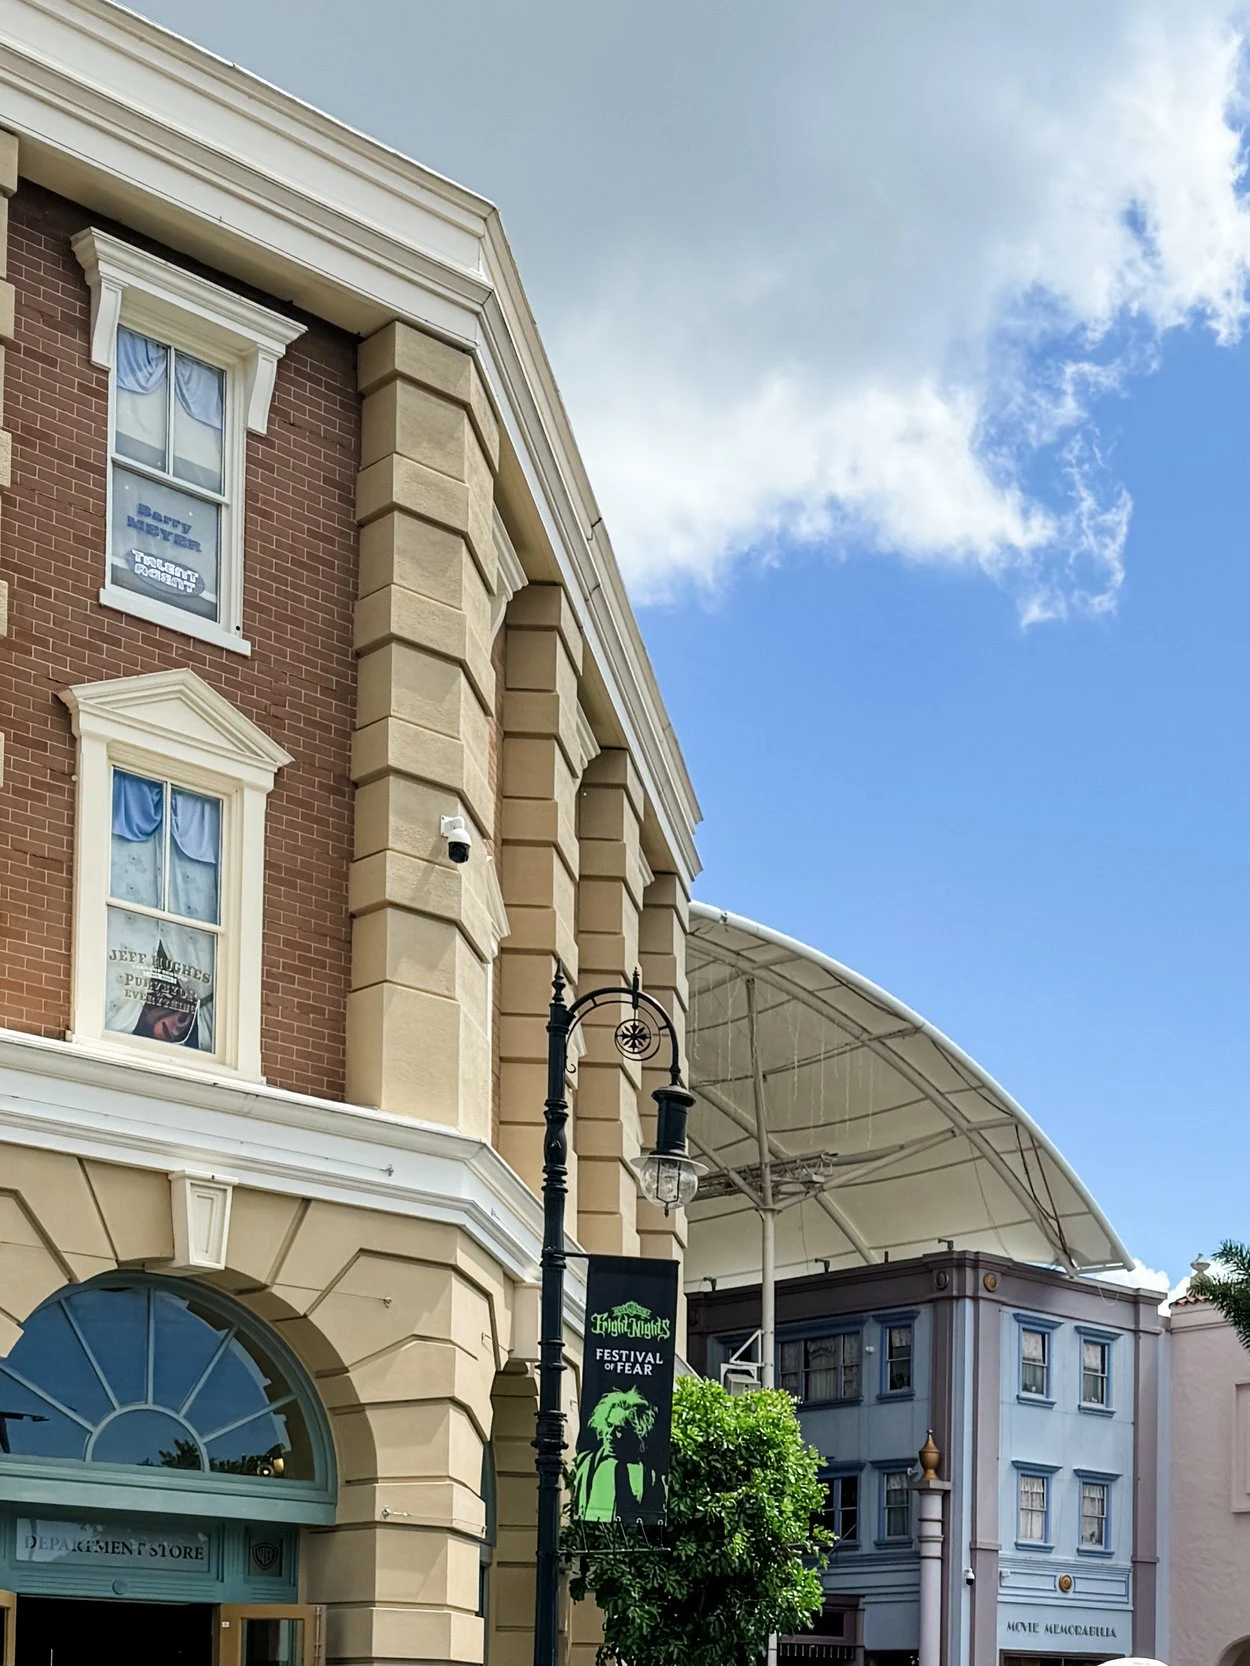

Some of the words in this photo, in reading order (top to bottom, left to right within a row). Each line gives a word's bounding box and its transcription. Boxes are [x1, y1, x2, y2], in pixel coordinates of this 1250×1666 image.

[127, 515, 202, 552] MEYER
[131, 549, 199, 583] TALENT
[134, 563, 196, 593] AGENT
[109, 949, 147, 963] JEFF
[151, 954, 211, 984] HUGHES
[591, 1312, 630, 1338] Fright
[596, 1348, 664, 1365] FESTIVAL
[604, 1363, 615, 1371] OF
[617, 1362, 653, 1376] FEAR
[25, 1535, 146, 1556] DEPARTMENT
[149, 1543, 205, 1560] STORE
[1006, 1621, 1039, 1634] MOVIE
[1044, 1623, 1118, 1638] MEMORABILIA
